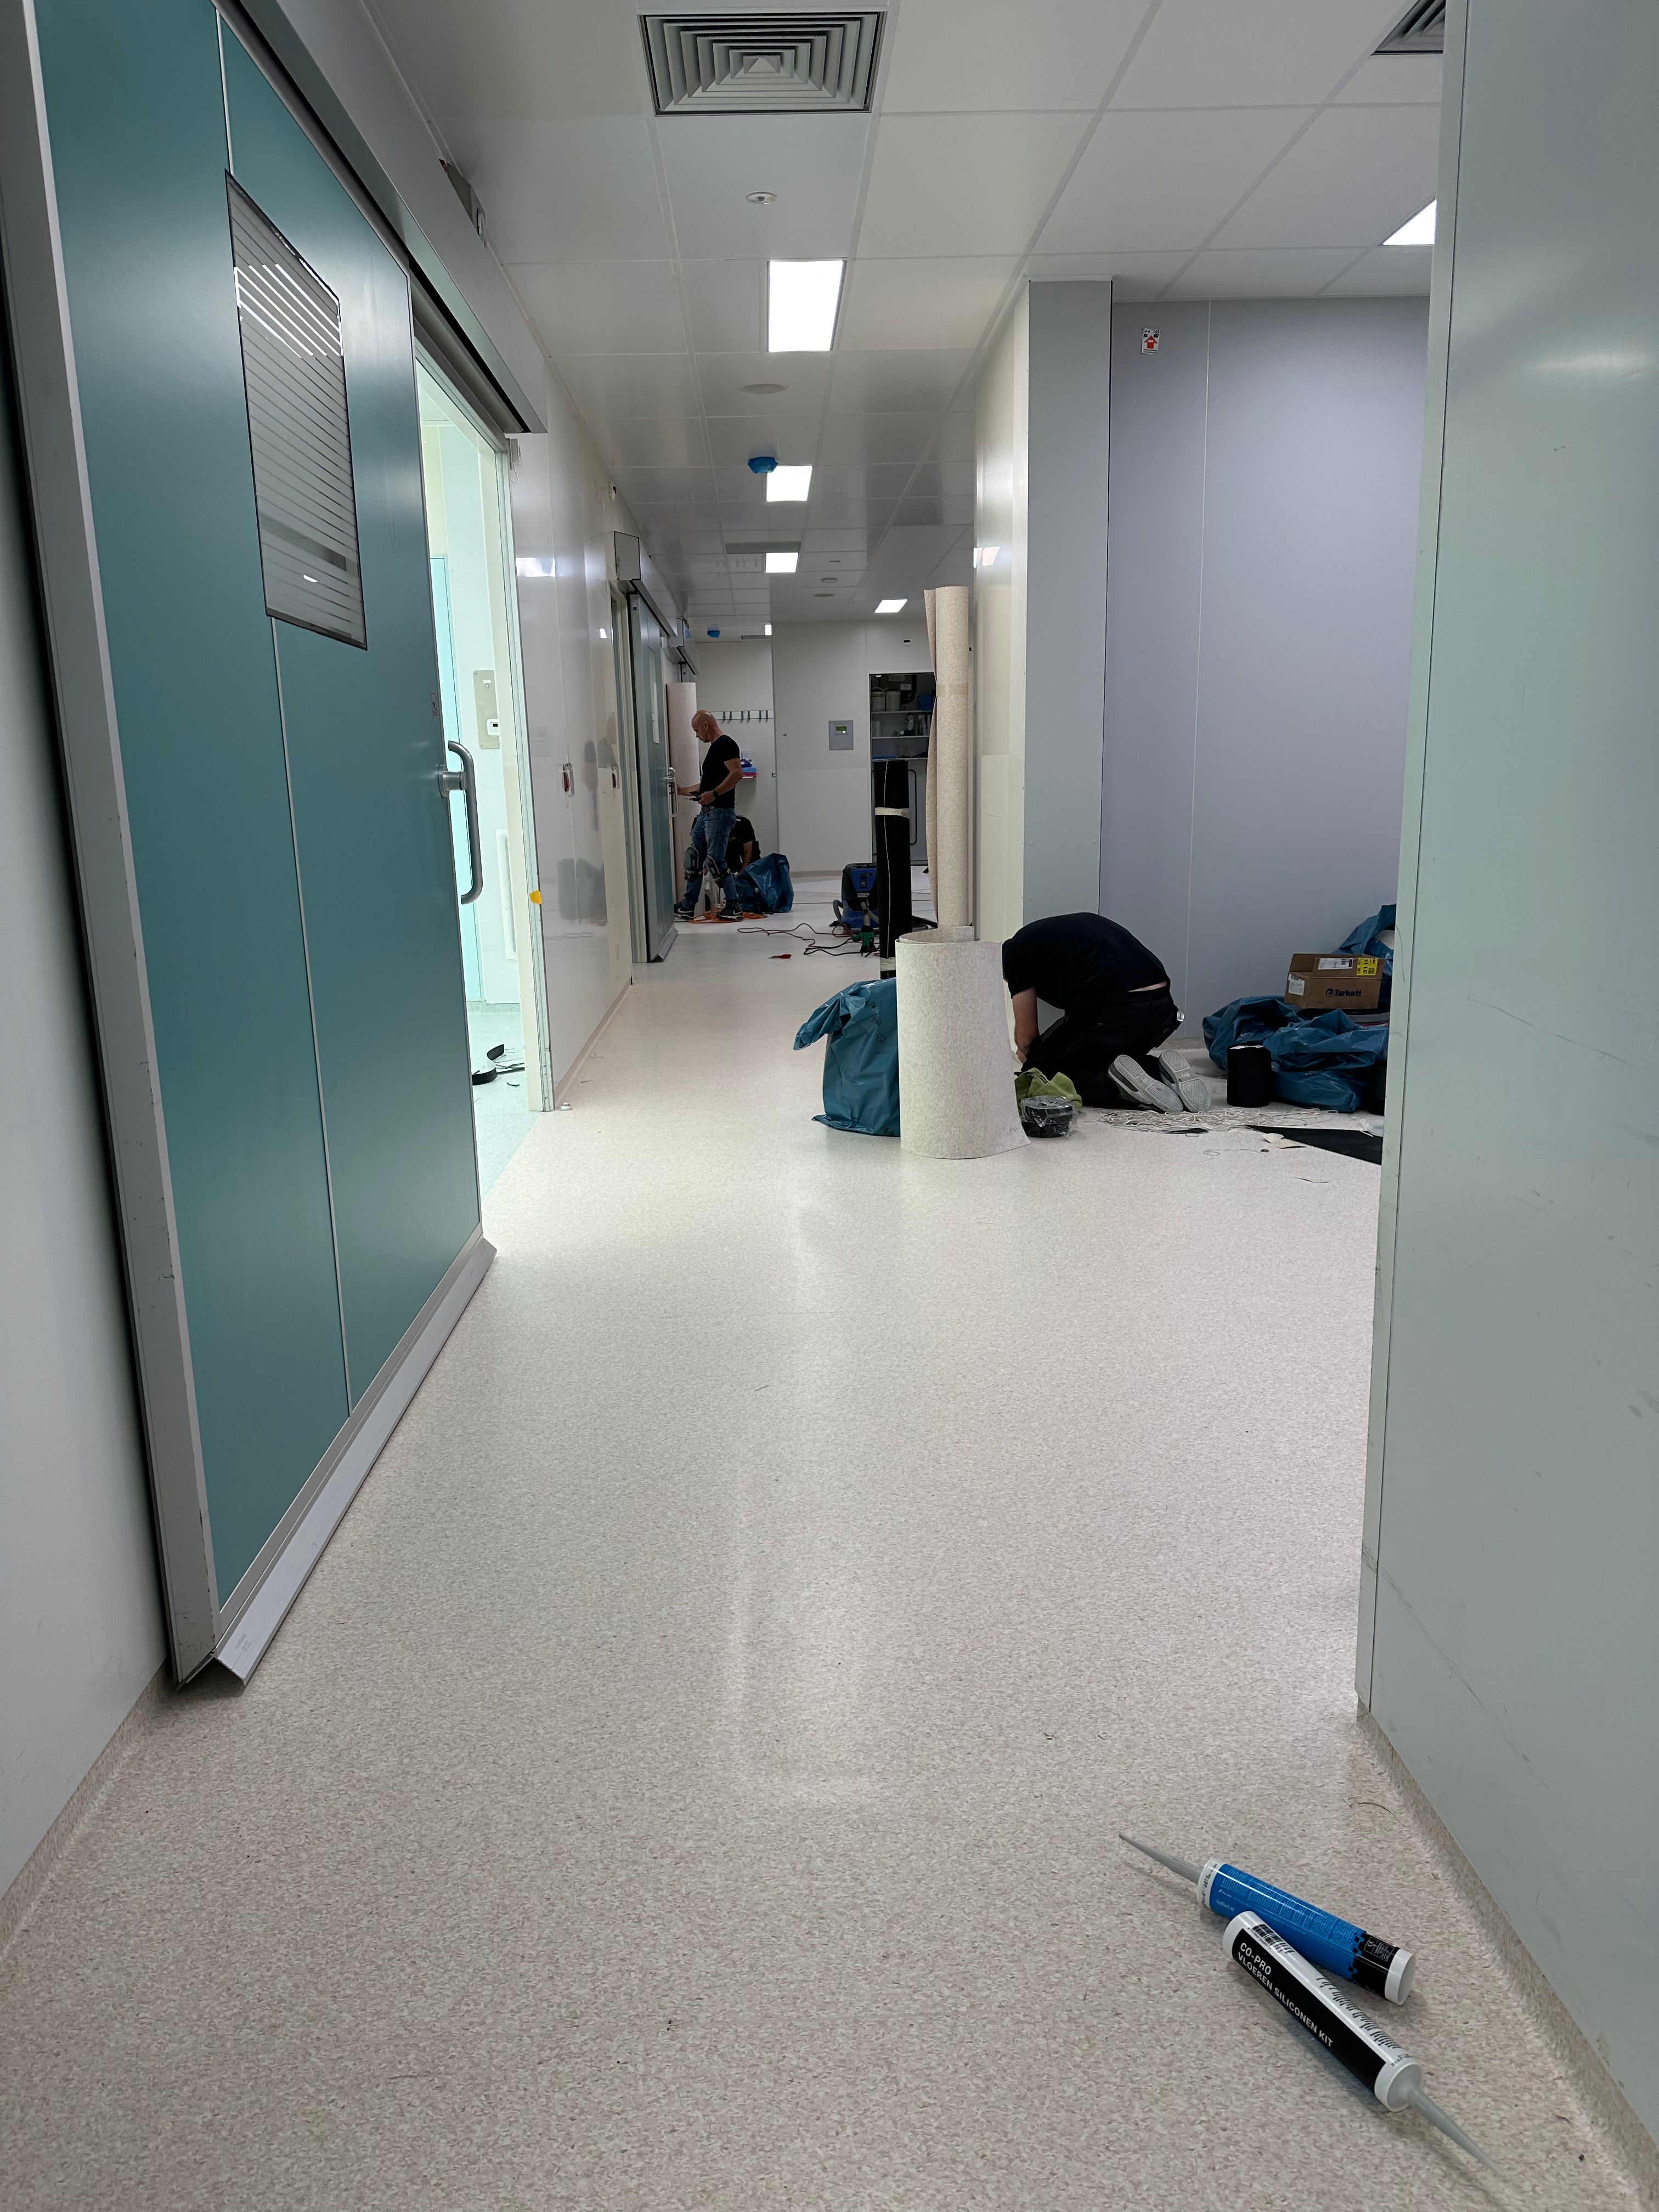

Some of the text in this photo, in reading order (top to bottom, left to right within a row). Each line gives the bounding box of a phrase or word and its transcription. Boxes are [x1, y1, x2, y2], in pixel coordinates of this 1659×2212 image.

[1240, 1943, 1272, 1975] CO-PRO
[1238, 1951, 1273, 1990] VLOEREN
[1274, 1988, 1317, 2033] SILICONEN
[1319, 2030, 1333, 2047] KIT
